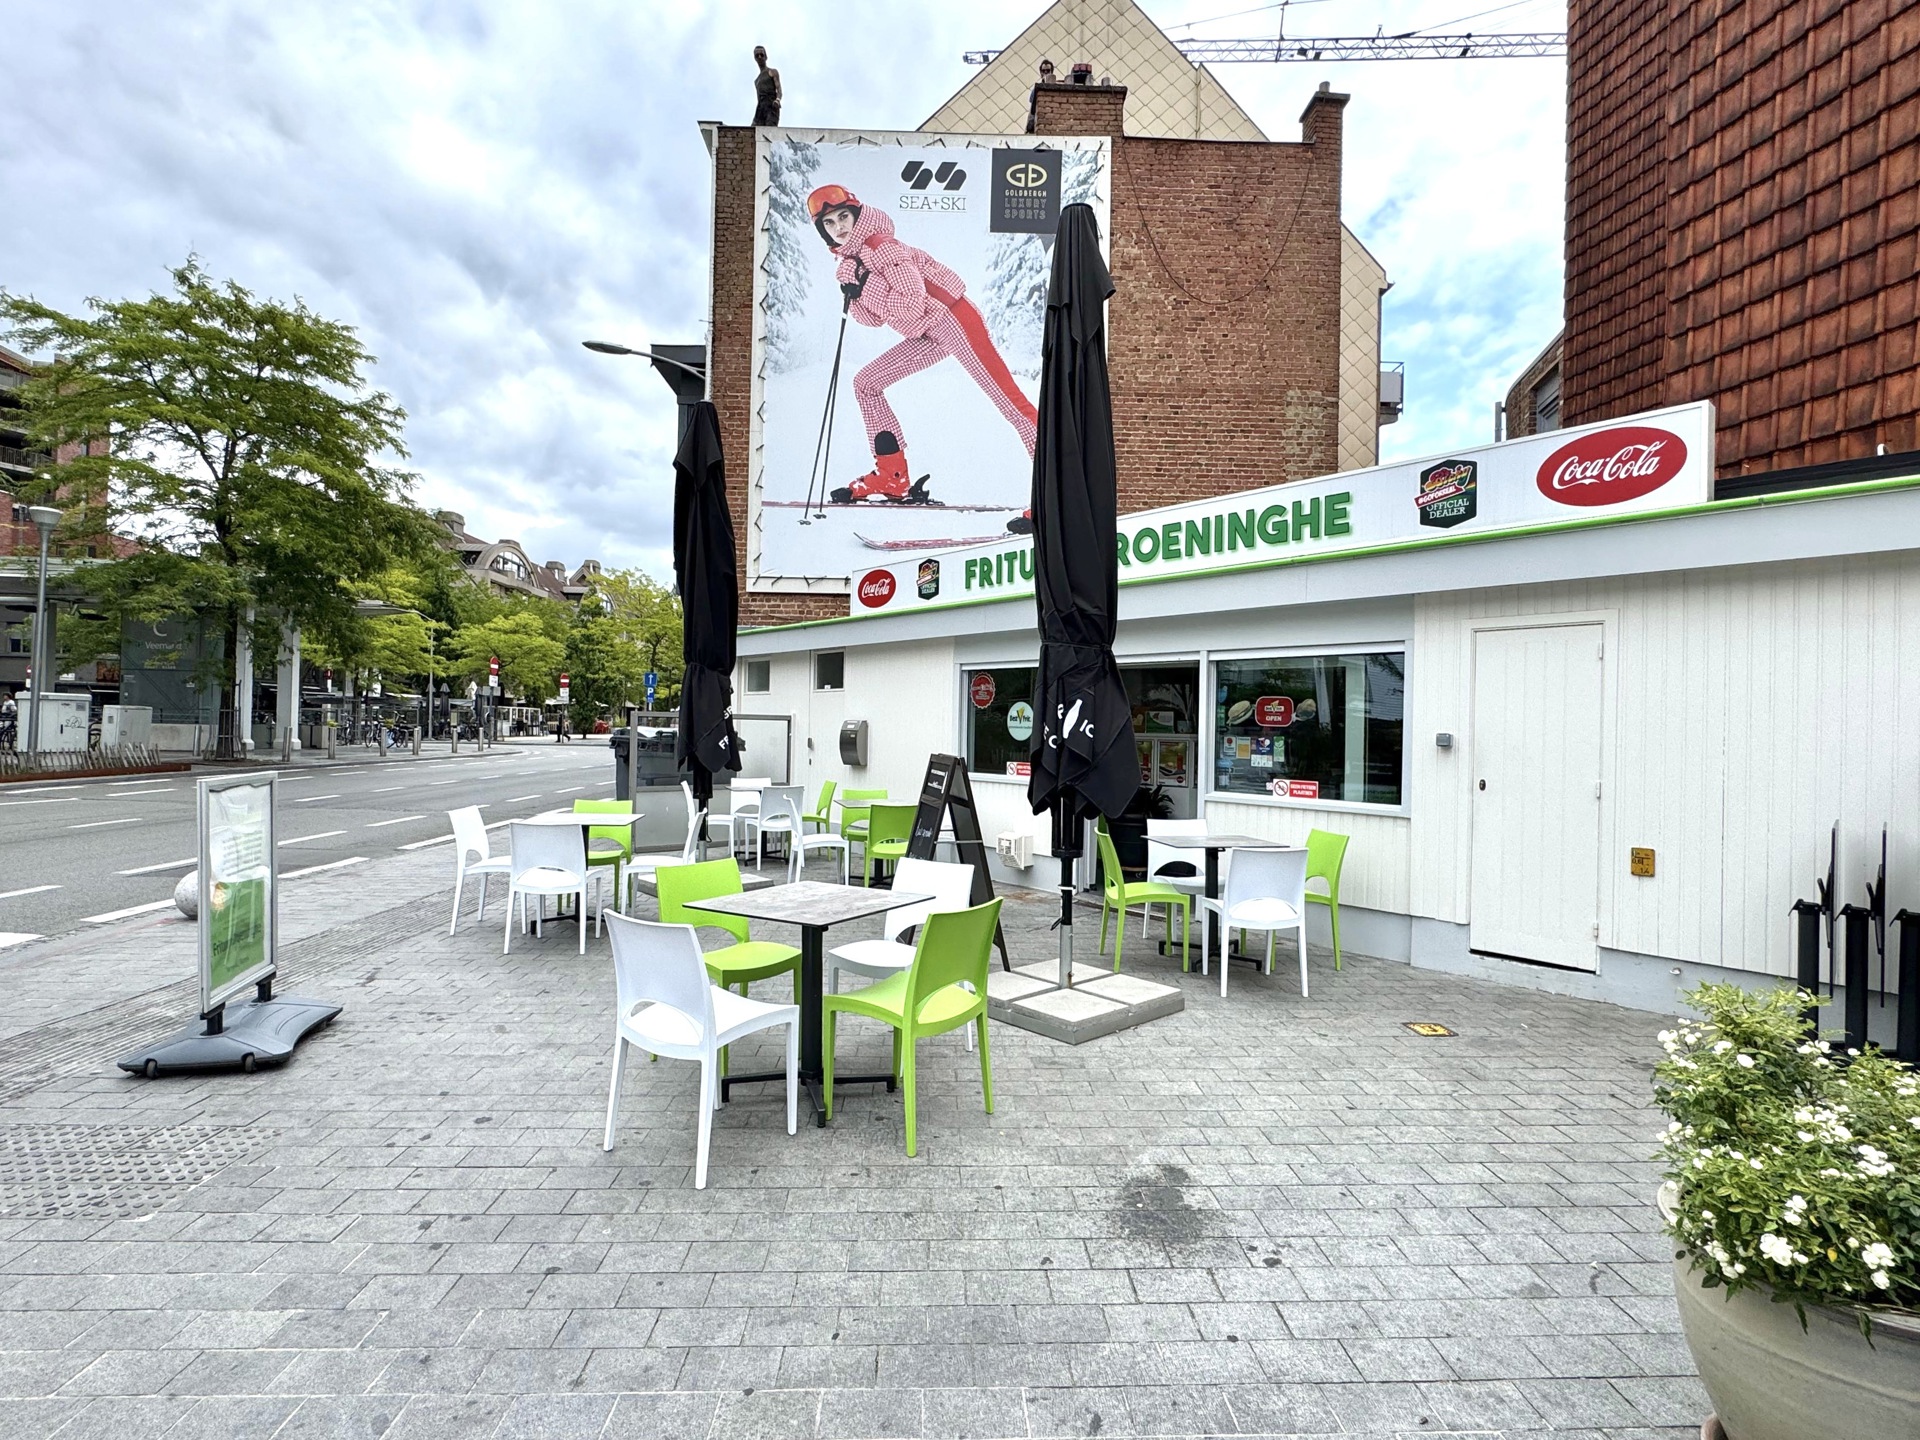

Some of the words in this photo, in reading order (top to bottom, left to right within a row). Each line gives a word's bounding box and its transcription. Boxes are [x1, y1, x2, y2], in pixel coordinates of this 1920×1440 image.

[1005, 189, 1047, 197] GOLDBERGH
[899, 195, 967, 211] SEA+SKI
[1004, 198, 1047, 209] LUXURY
[1003, 209, 1046, 220] SPORTS
[1552, 439, 1668, 490] Coca-Cola
[1426, 498, 1470, 512] OFFICIAL
[1429, 507, 1466, 519] DEALER
[965, 547, 1035, 590] FRITU
[1116, 491, 1351, 566] ROENINGHE
[647, 687, 655, 696] P
